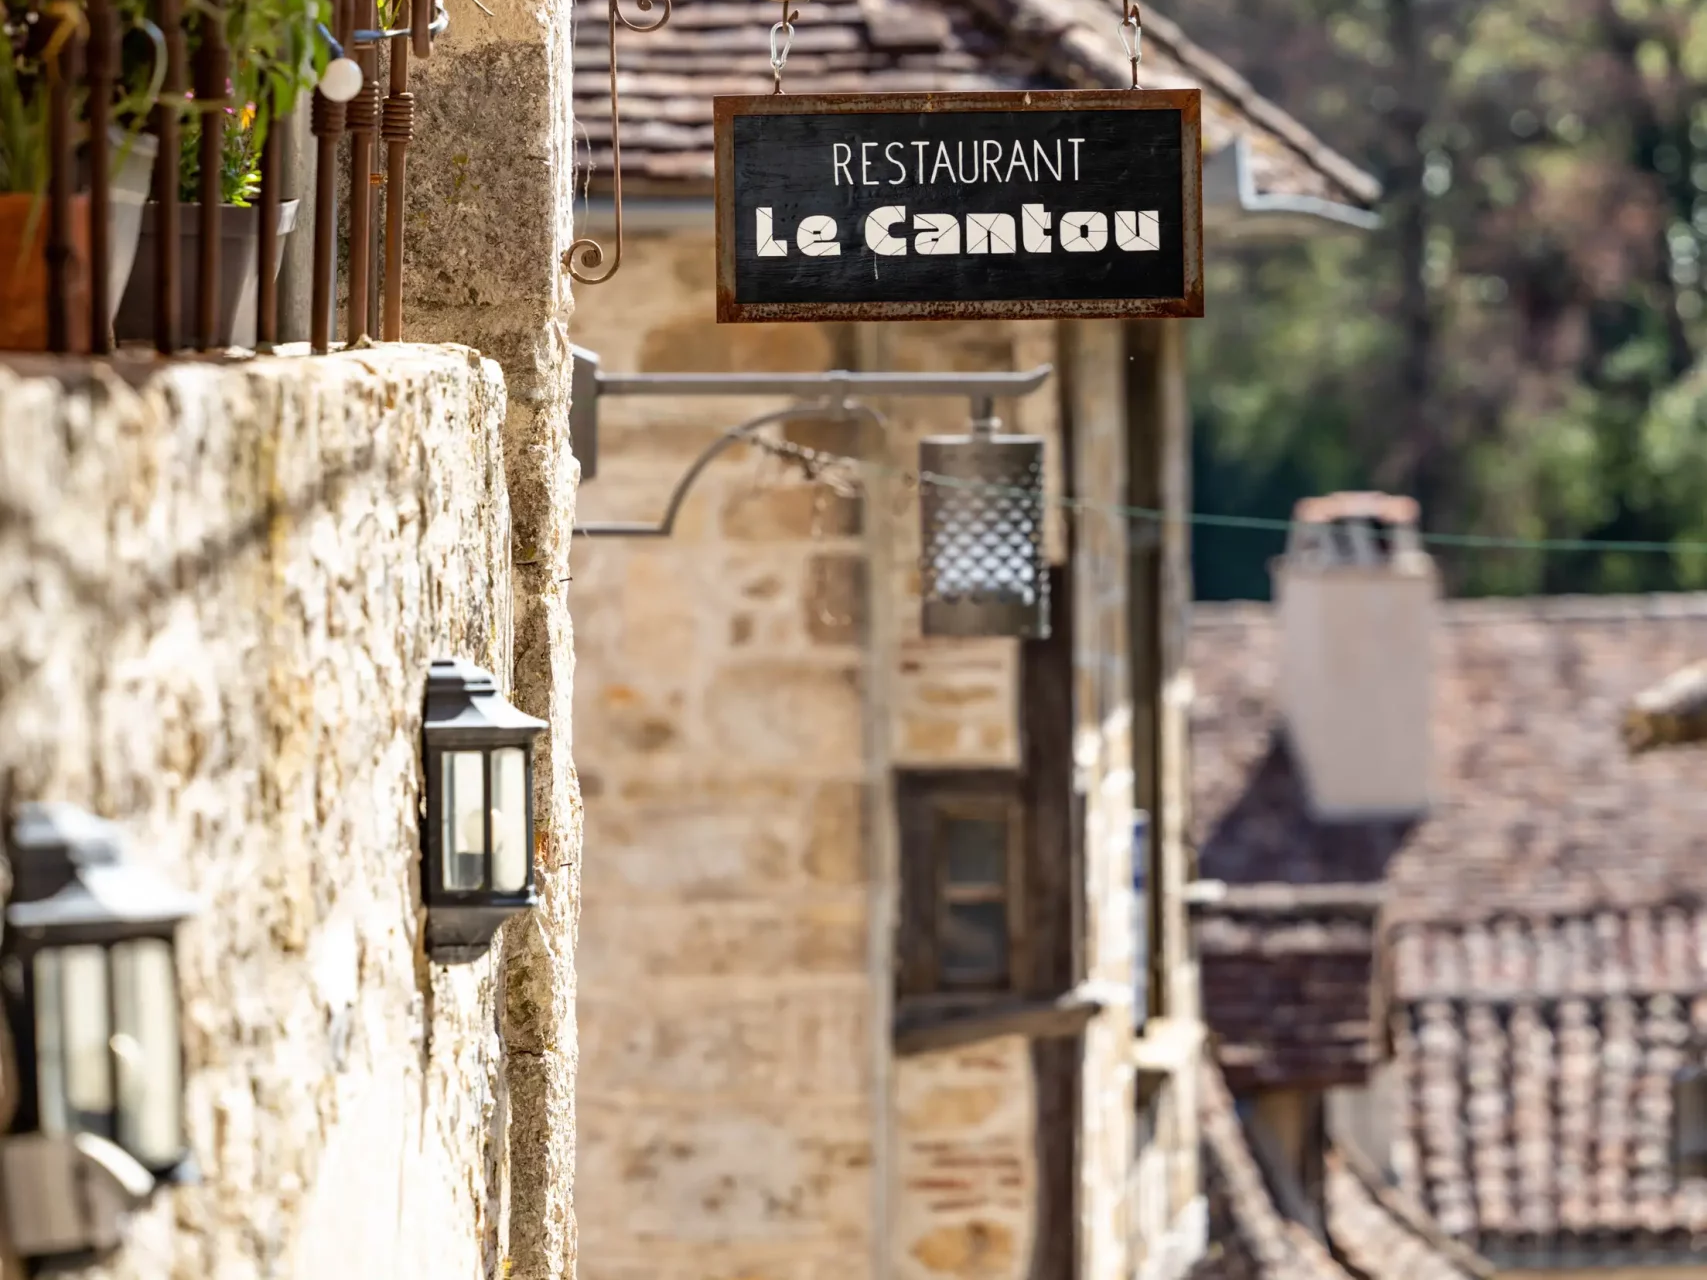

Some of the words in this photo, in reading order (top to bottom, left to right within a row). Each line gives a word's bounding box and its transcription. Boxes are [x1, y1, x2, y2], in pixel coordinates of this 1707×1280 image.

[834, 138, 1085, 186] RESTAURANT
[756, 207, 841, 257] Le
[865, 204, 1160, 256] Cantou
